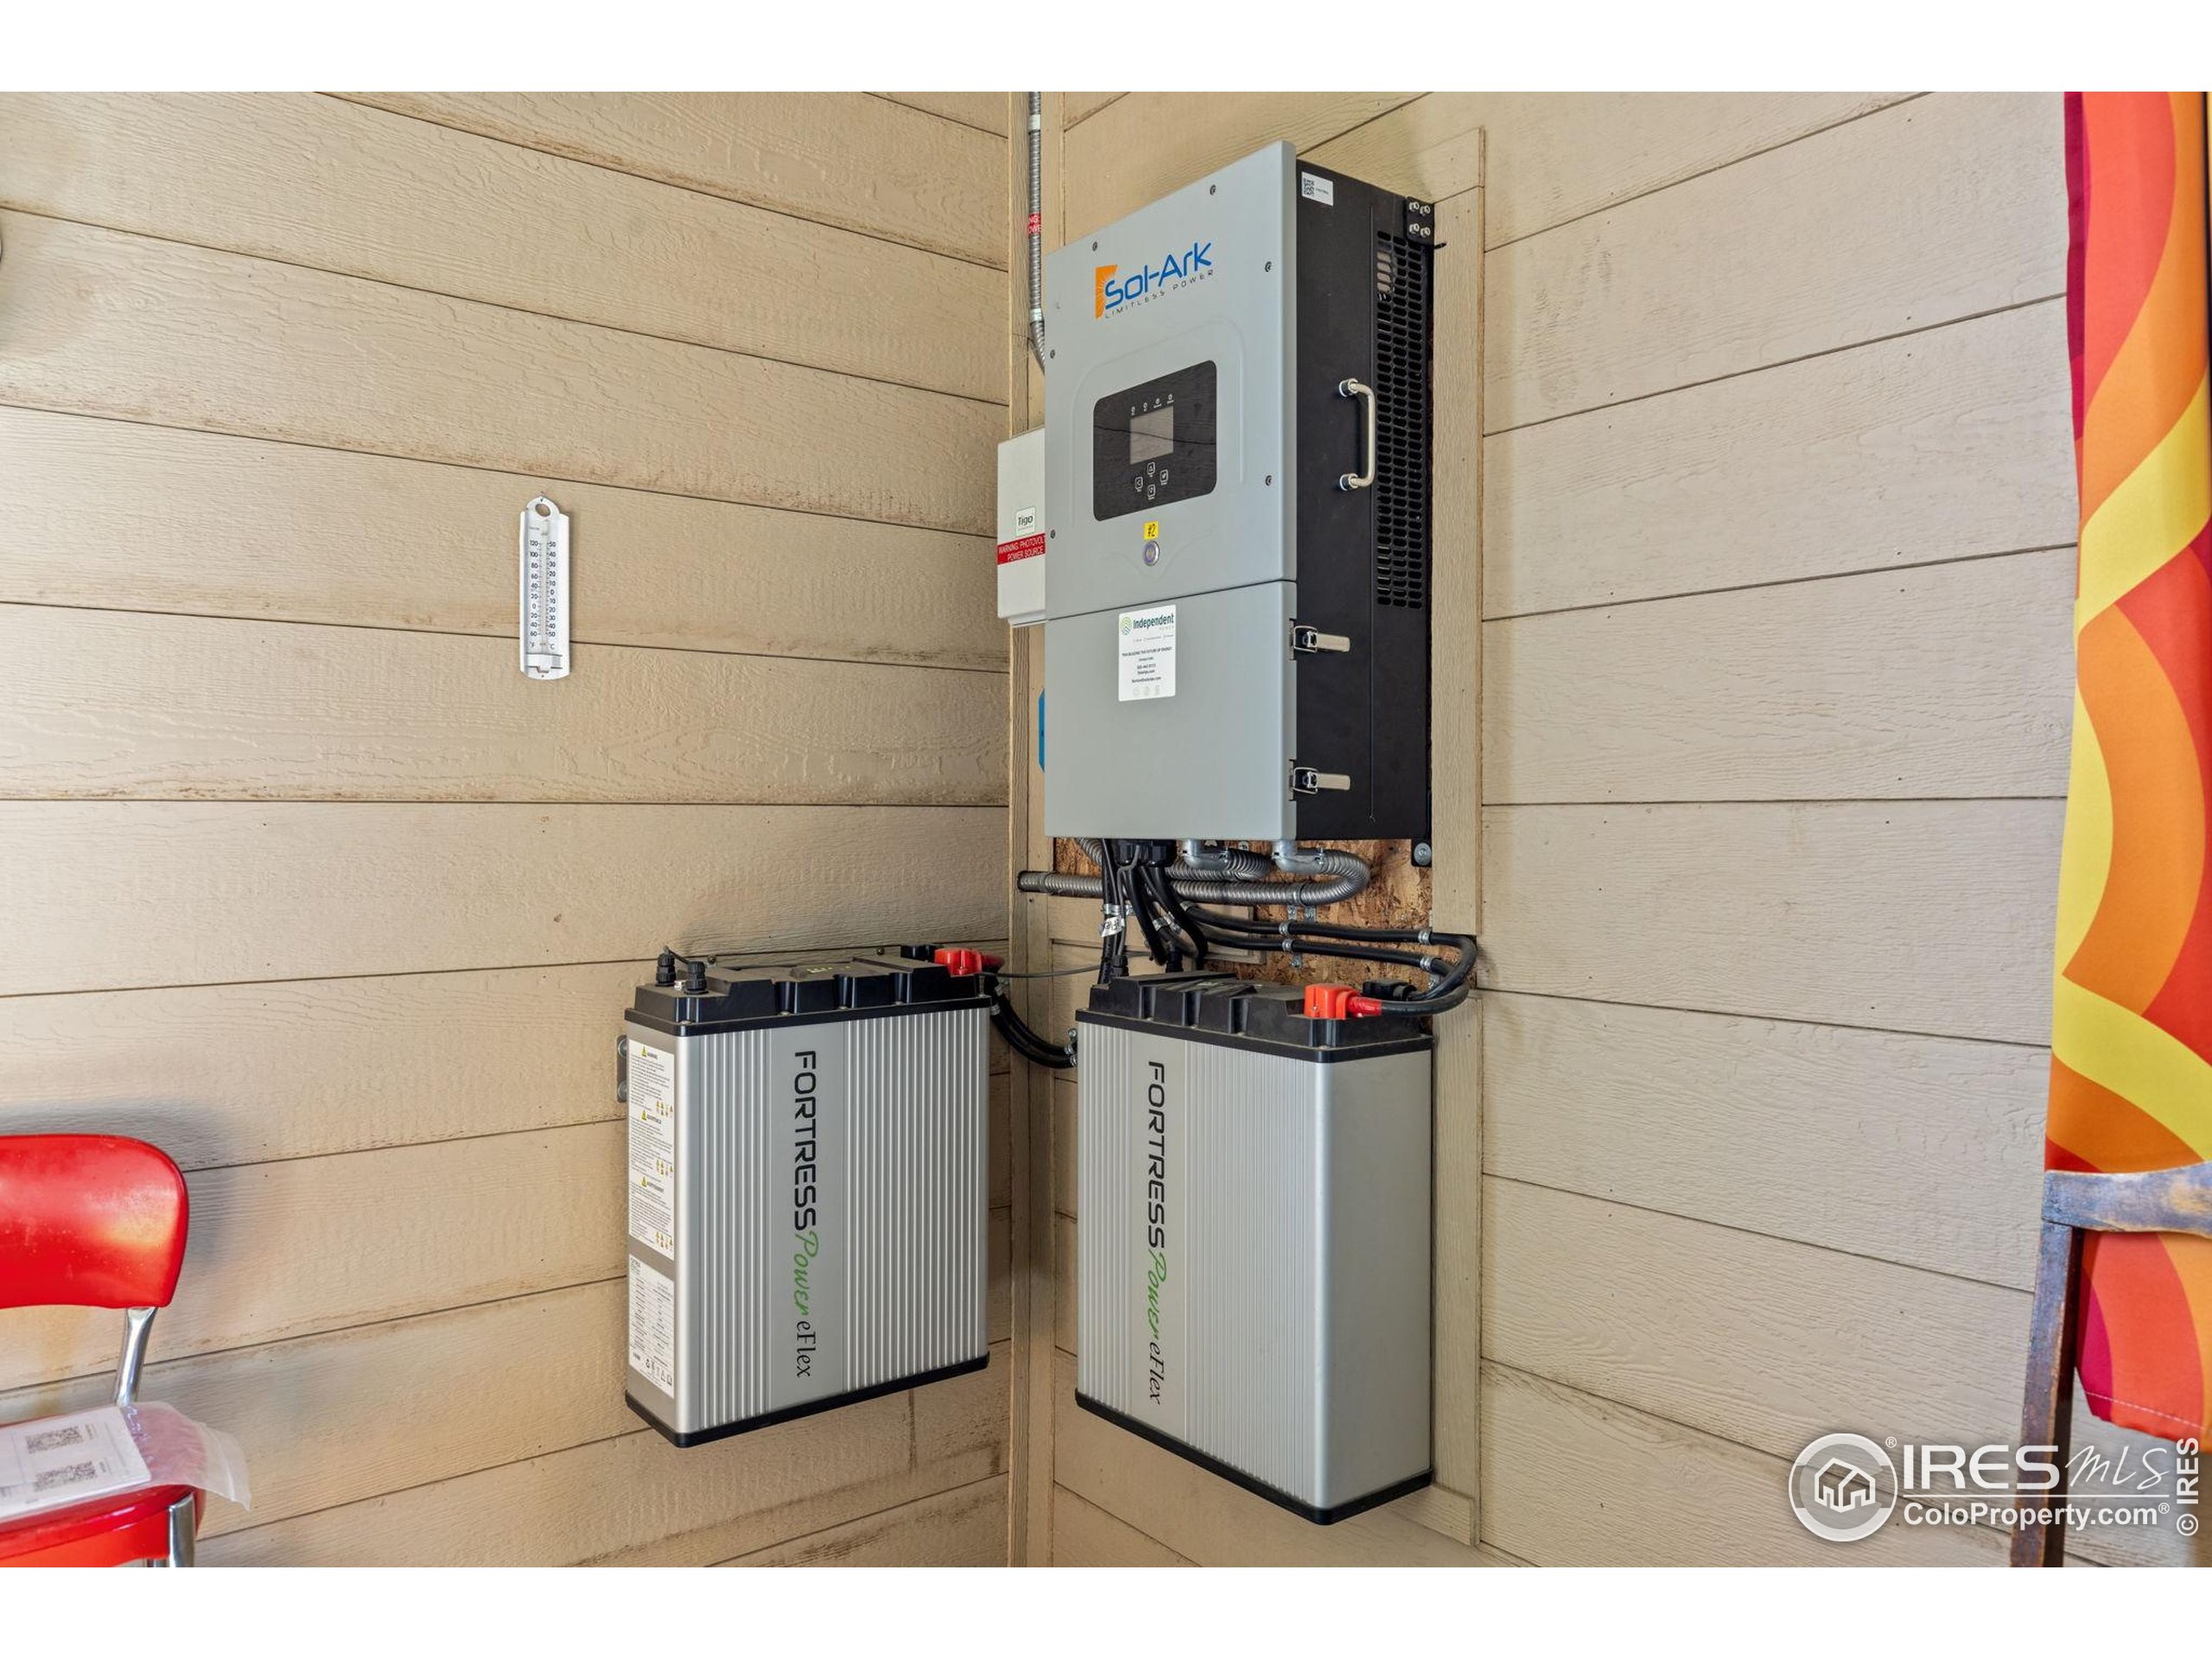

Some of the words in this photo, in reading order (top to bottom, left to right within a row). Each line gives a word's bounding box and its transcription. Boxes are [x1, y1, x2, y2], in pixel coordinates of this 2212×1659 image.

[1105, 242, 1211, 309] Sol-Ark
[1105, 290, 1166, 319] LIMITLESS
[1173, 270, 1214, 291] POWER
[1018, 515, 1033, 526] Tigo
[1007, 550, 1024, 562] POWER
[1024, 545, 1045, 558] SOURCE
[1133, 613, 1174, 629] Independent
[793, 1049, 817, 1231] FORTRESS
[1148, 1060, 1165, 1249] FORTRESS
[793, 1230, 819, 1317] Power
[1147, 1249, 1167, 1340] Power
[796, 1319, 817, 1378] eFlex
[1148, 1341, 1165, 1405] eFlex
